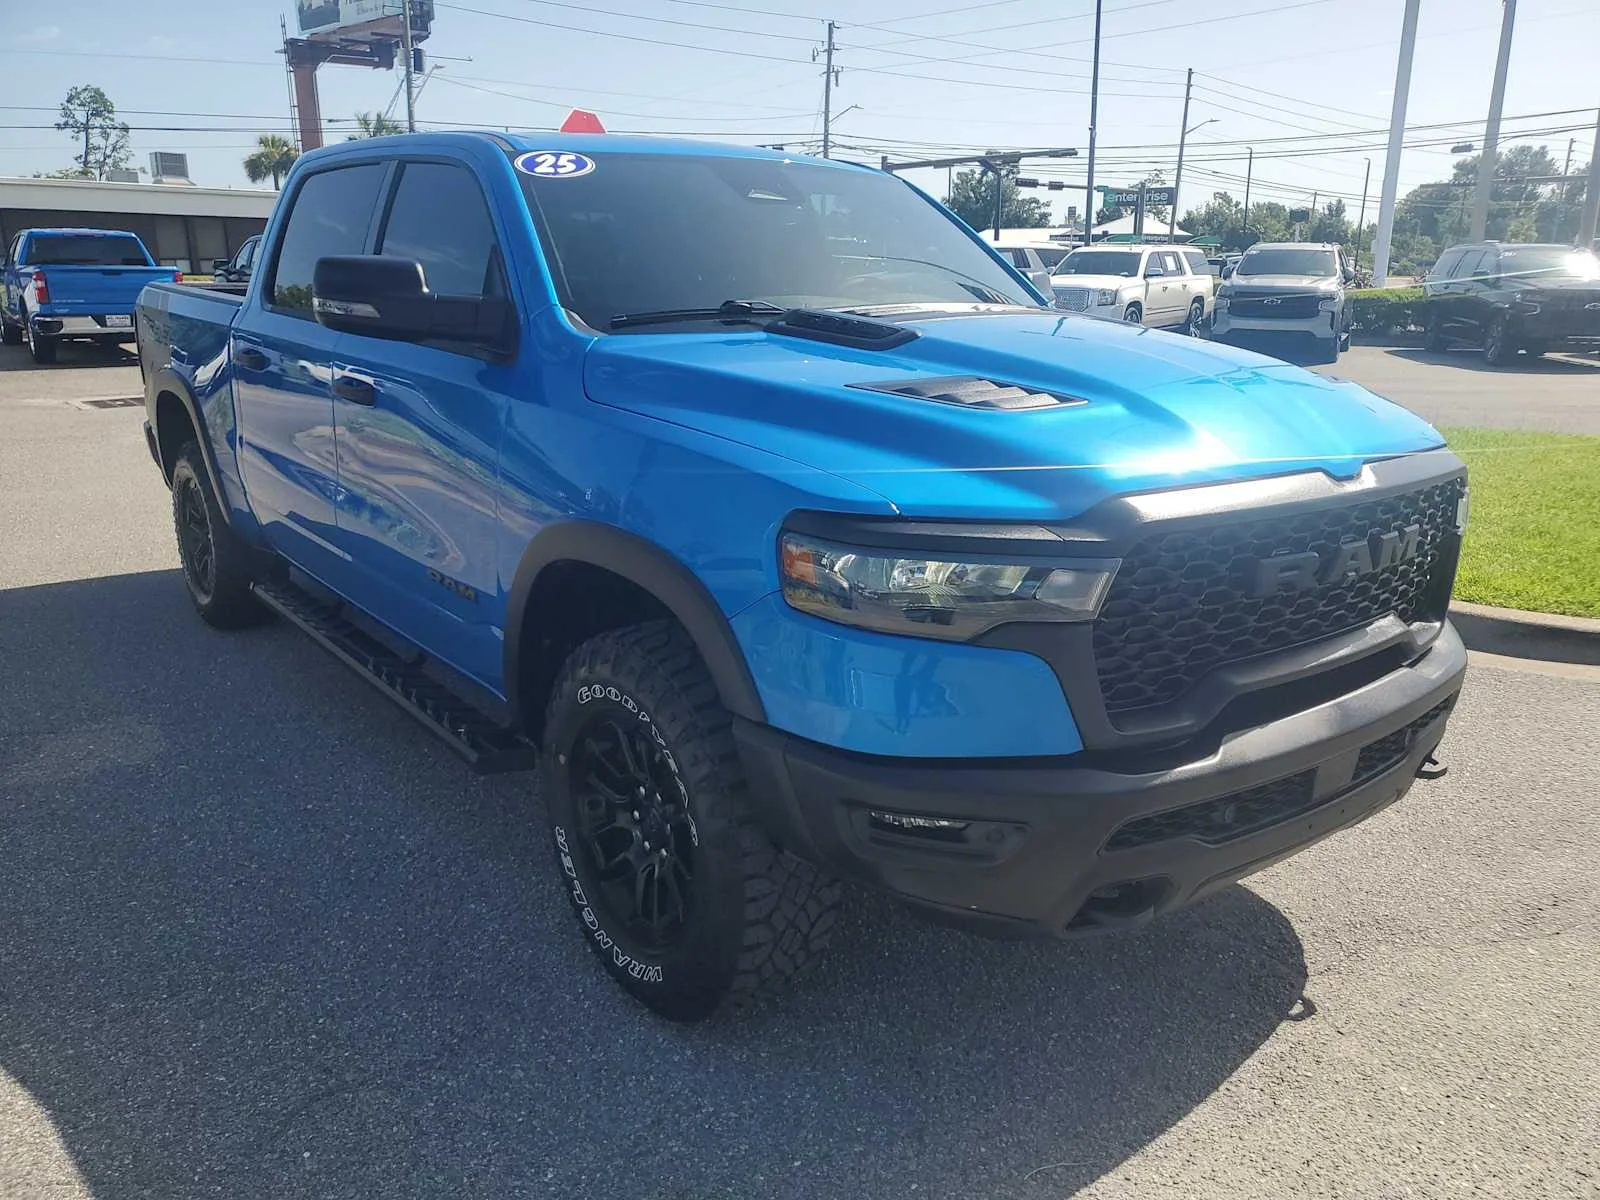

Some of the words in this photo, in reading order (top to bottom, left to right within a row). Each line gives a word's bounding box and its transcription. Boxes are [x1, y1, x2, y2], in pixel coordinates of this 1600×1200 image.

[534, 154, 577, 174] 25
[1259, 524, 1420, 596] RAM
[577, 684, 699, 847] GOODYEAR
[555, 826, 663, 982] WRANGLER
